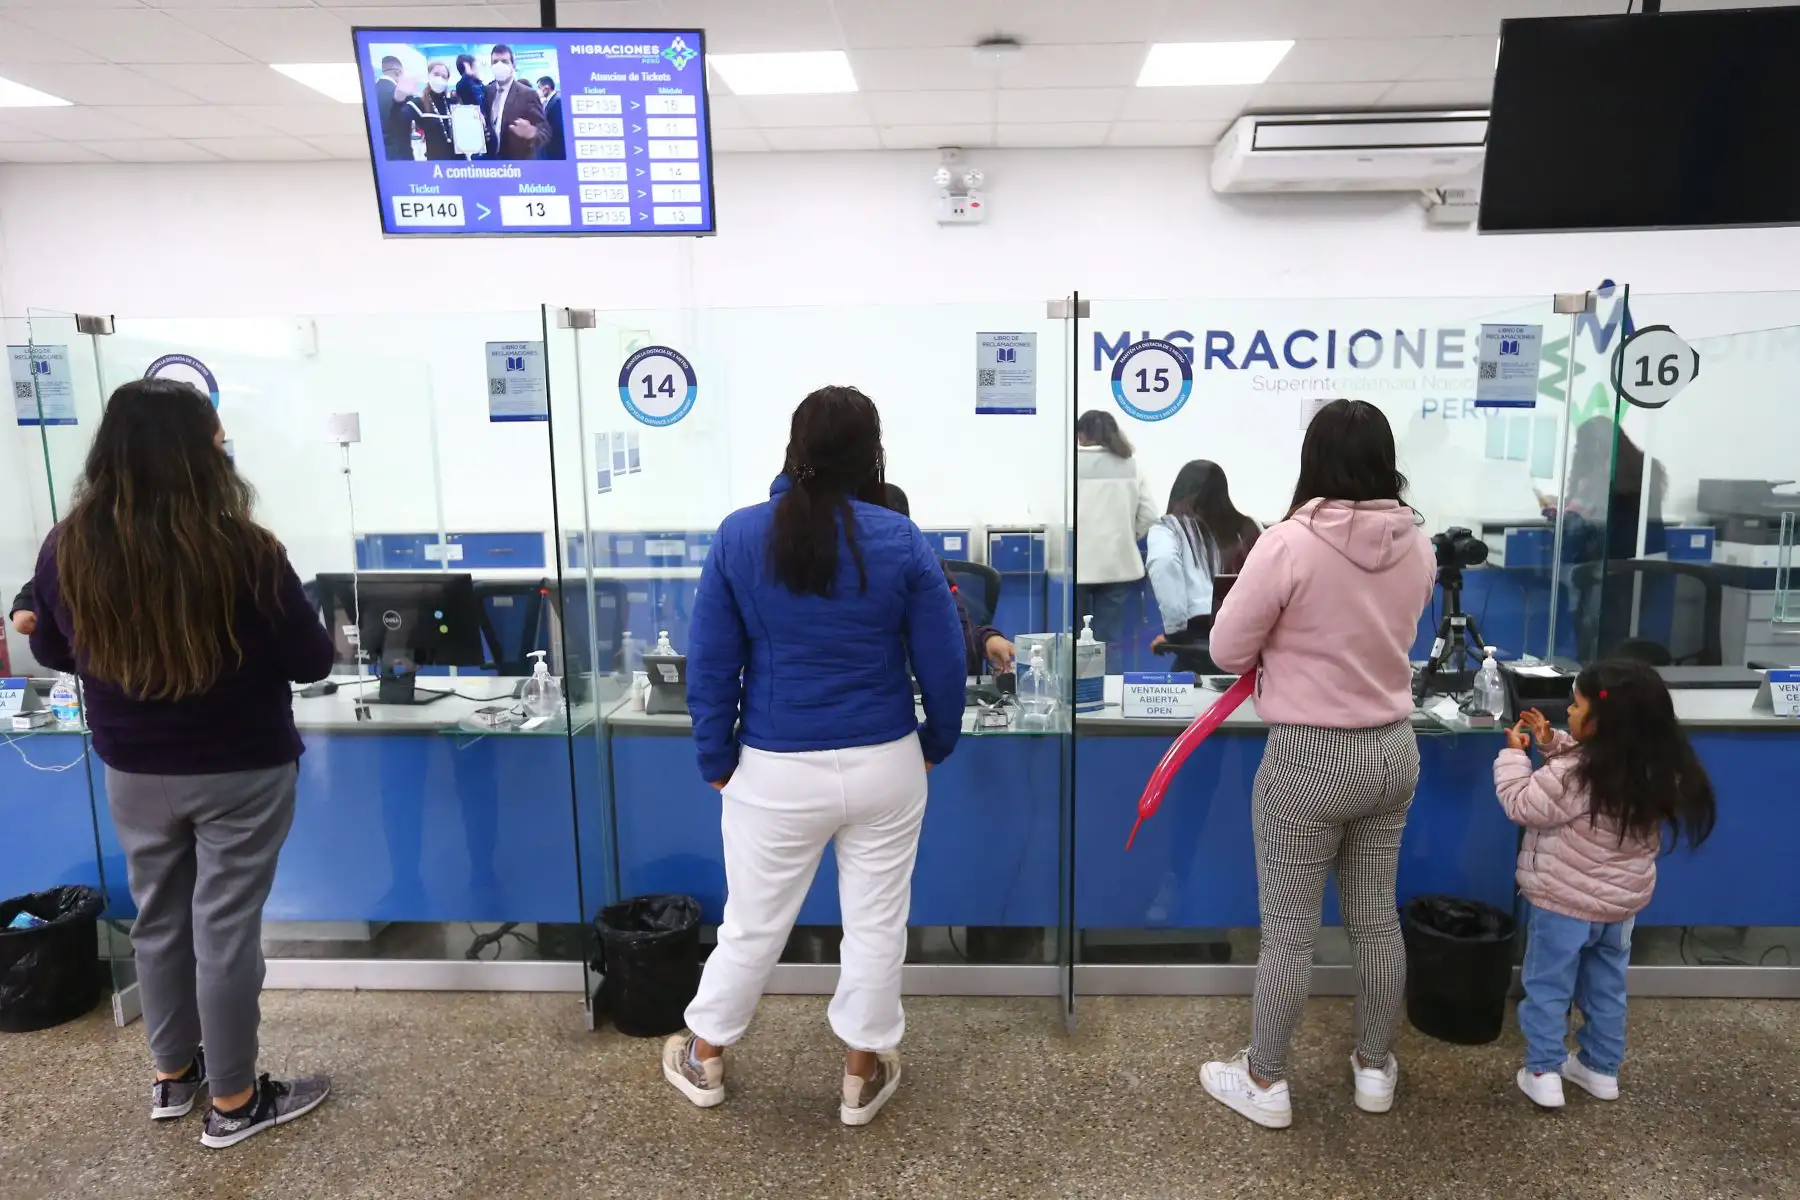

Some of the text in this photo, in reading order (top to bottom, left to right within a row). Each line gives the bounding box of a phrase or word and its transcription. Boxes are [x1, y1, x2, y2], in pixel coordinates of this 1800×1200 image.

[570, 45, 660, 55] MIGRACIONES
[641, 72, 671, 81] Tickets
[433, 165, 521, 178] A continuación
[410, 184, 440, 193] Ticket
[518, 183, 556, 193] Módulo
[400, 202, 457, 217] EP140
[525, 202, 545, 217] 13
[1093, 329, 1480, 371] MGRACIONE
[1634, 354, 1679, 386] 16
[1135, 368, 1169, 392] 15
[641, 374, 675, 398] 14
[1130, 686, 1187, 694] VENTANILLA
[1139, 696, 1179, 704] ABIERTA
[1146, 707, 1172, 715] OPEN
